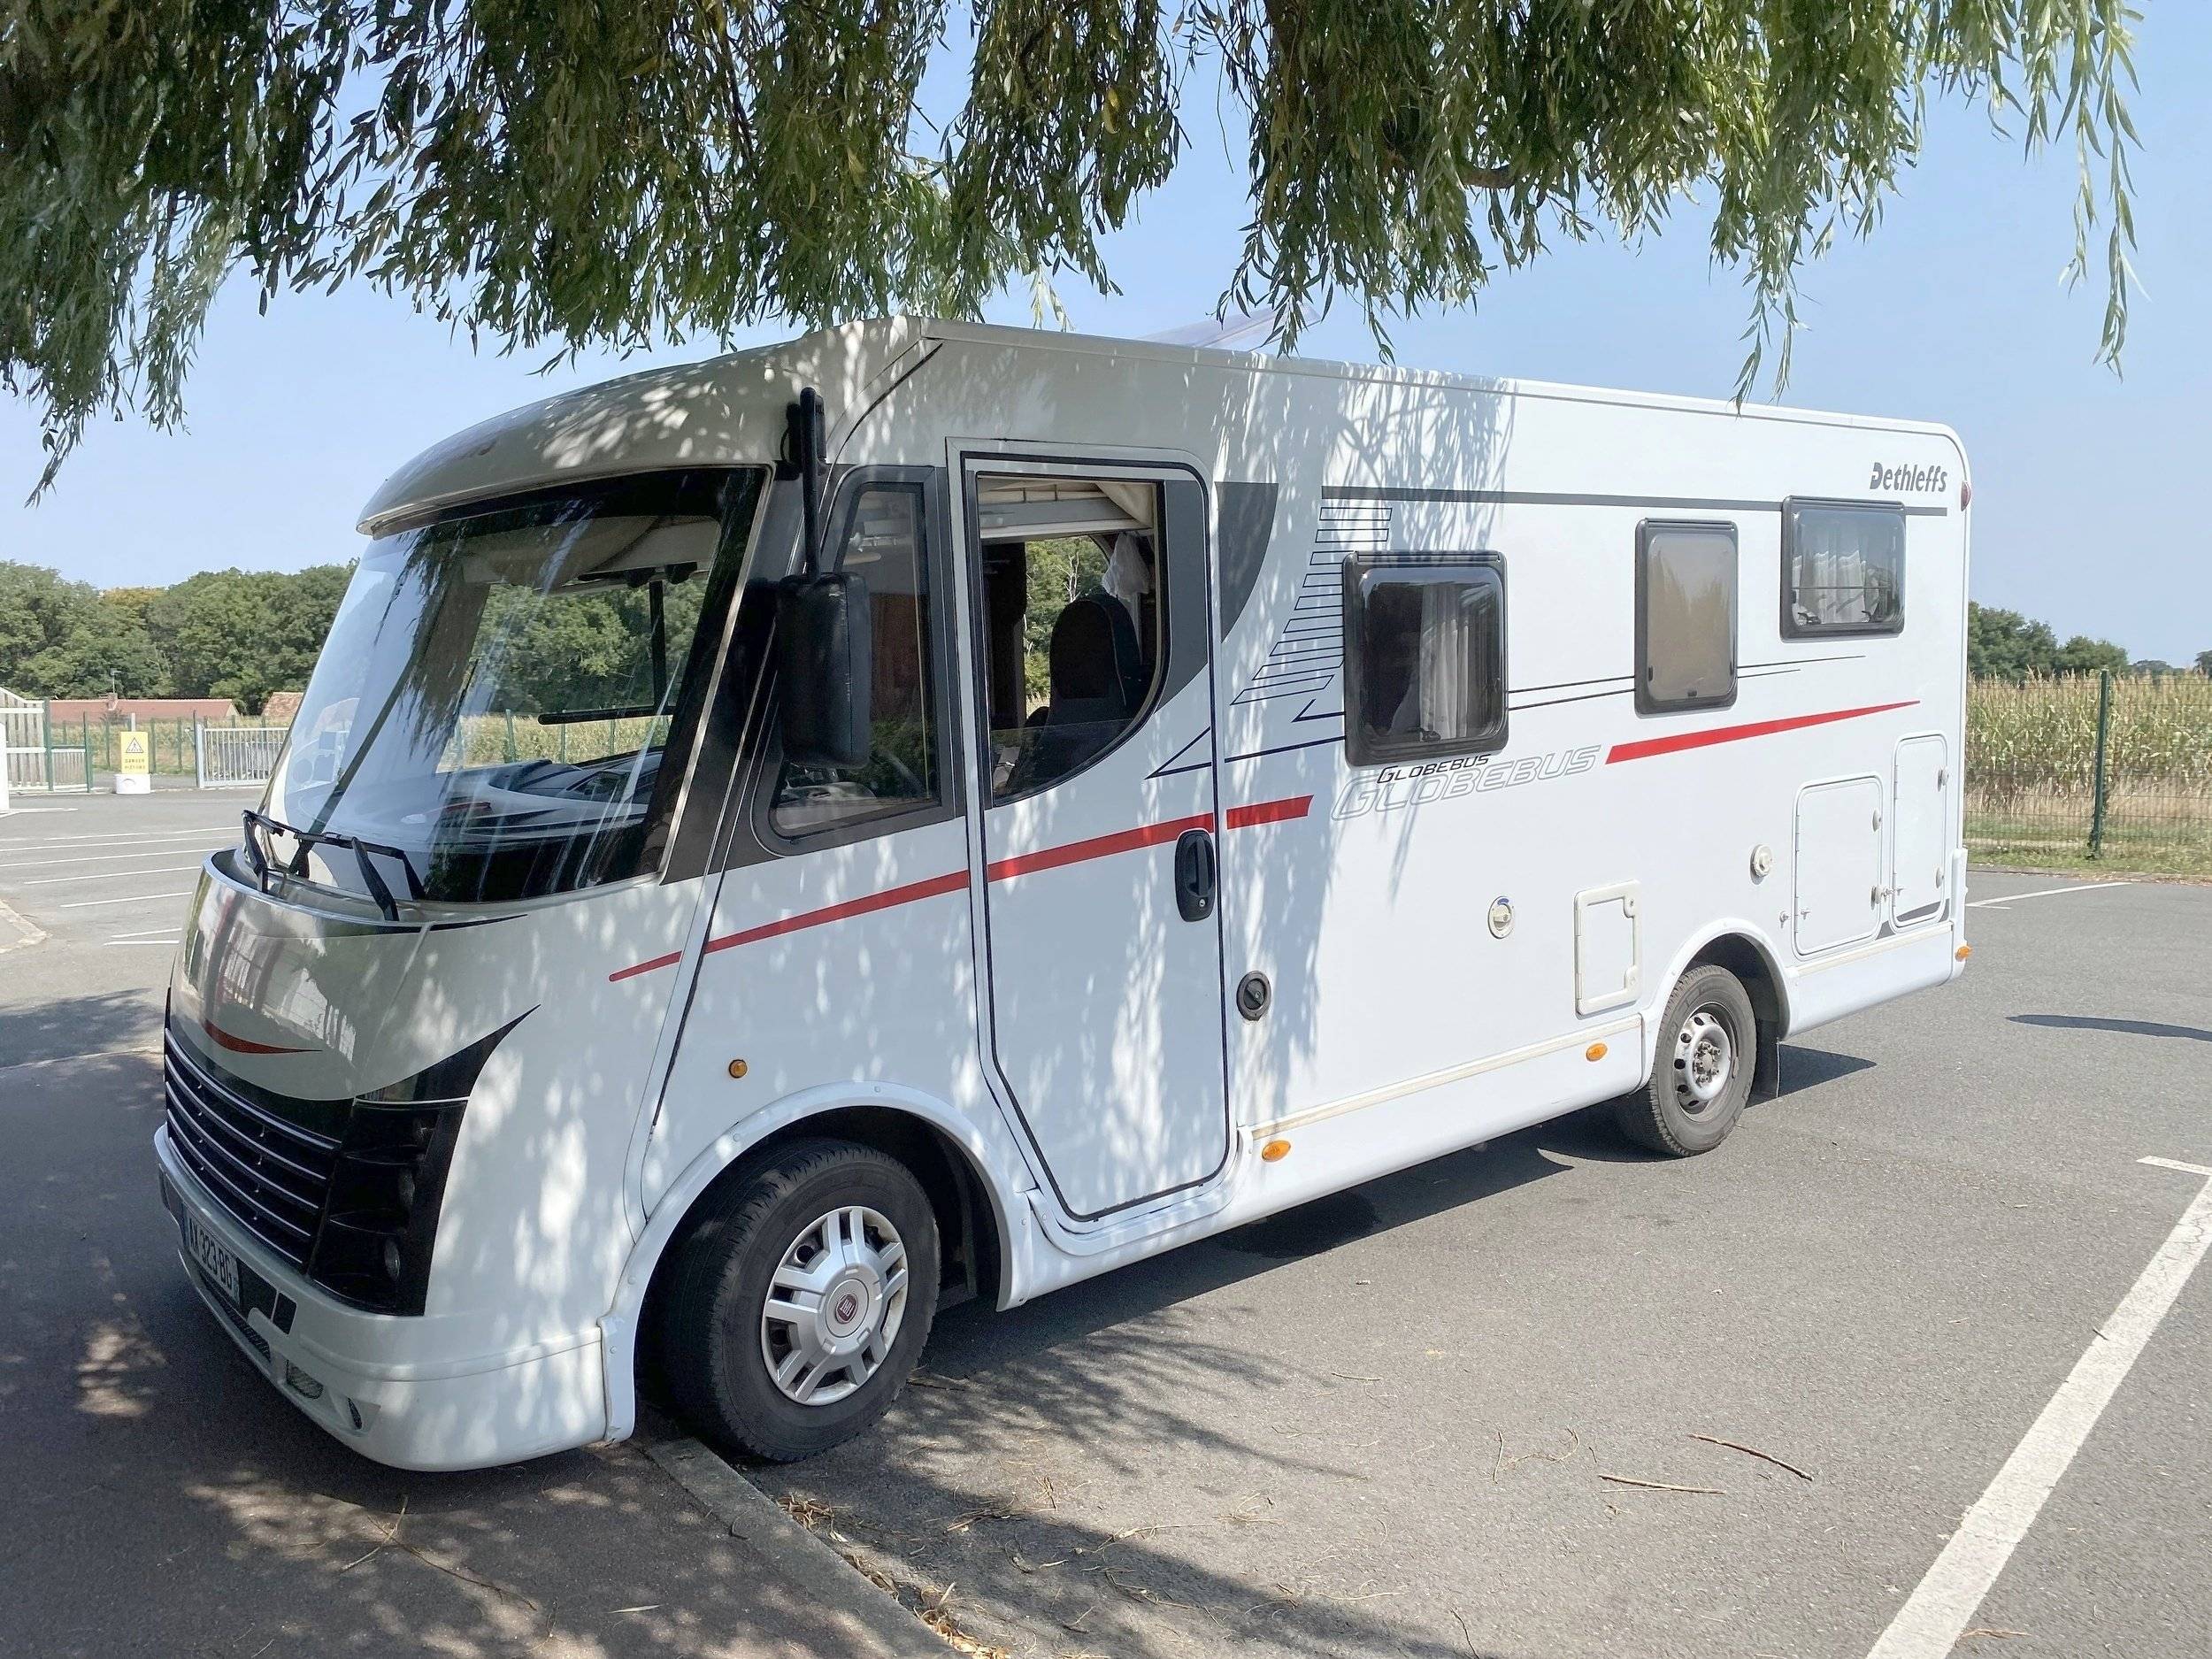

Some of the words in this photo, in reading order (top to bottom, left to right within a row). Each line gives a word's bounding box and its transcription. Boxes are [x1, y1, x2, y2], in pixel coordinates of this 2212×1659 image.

[1870, 462, 1947, 492] Dethleffs
[1331, 743, 1602, 821] GLOBEBUS
[1377, 753, 1492, 784] GLOBEBUS
